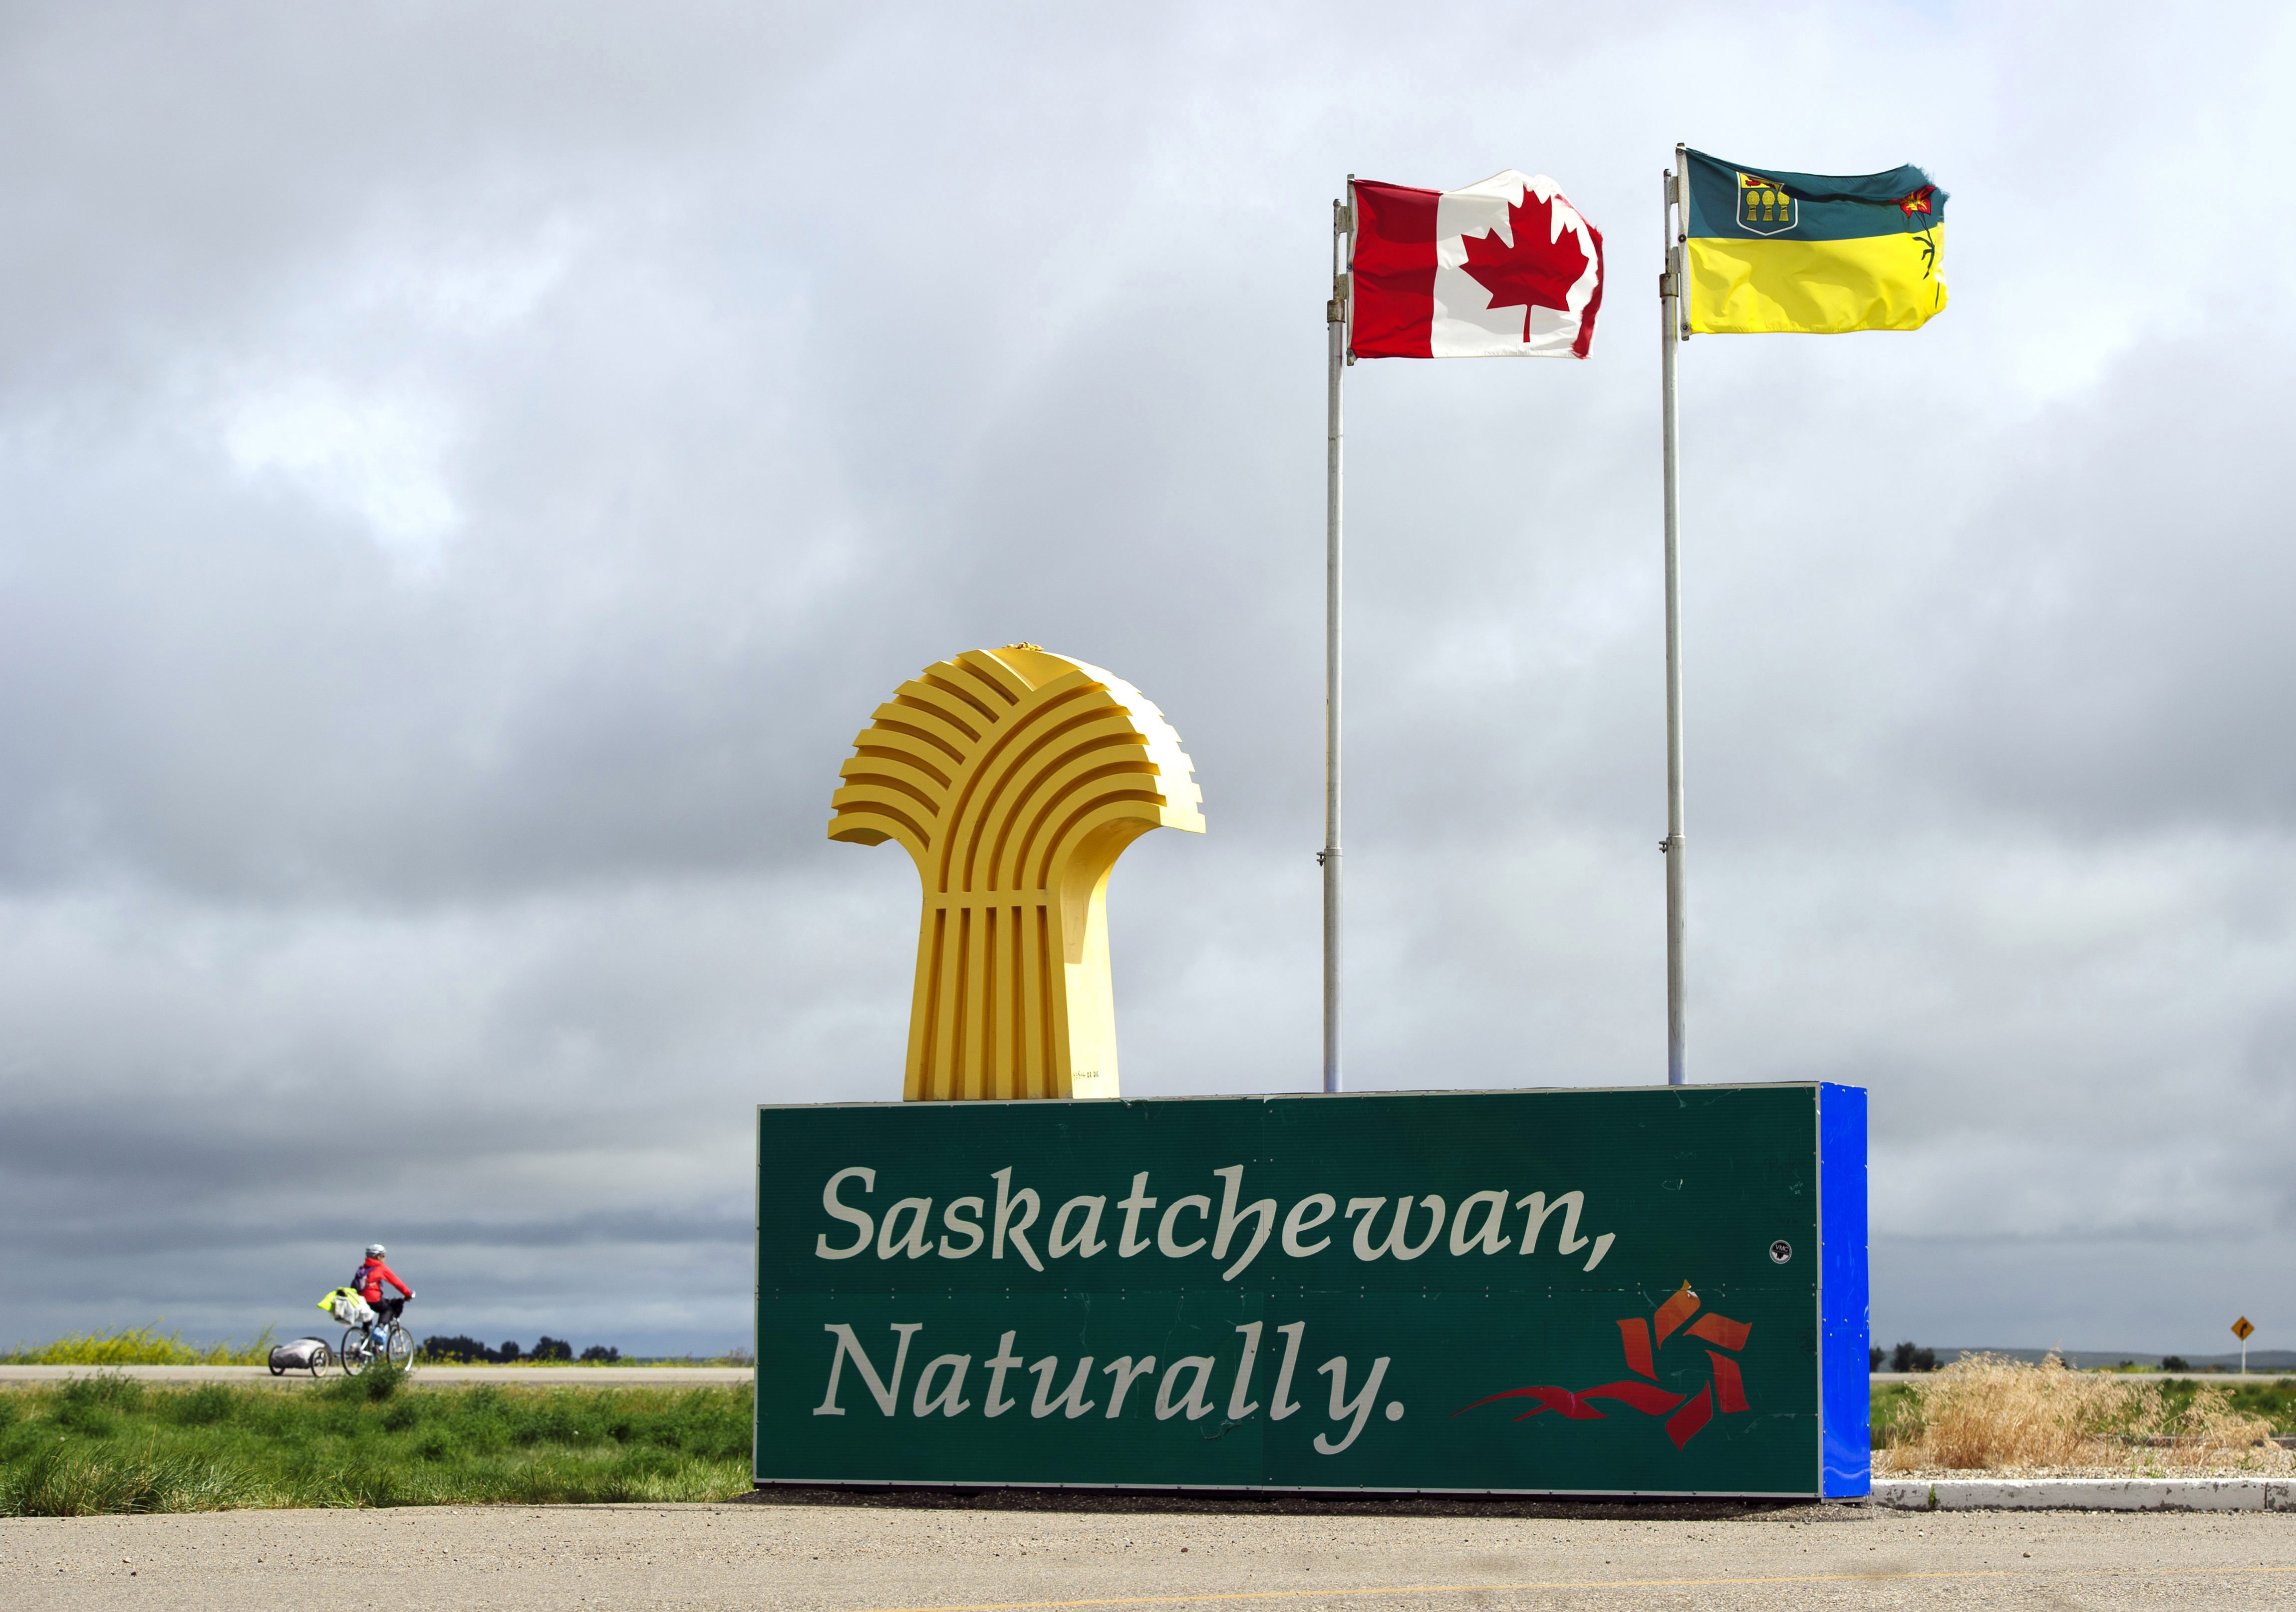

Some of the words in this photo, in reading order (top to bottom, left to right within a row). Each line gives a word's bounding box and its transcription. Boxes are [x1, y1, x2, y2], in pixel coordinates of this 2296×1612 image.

[815, 1164, 1616, 1282] Saskatchewan,
[1775, 1244, 1789, 1252] VMC
[813, 1321, 1405, 1455] Naturally.
